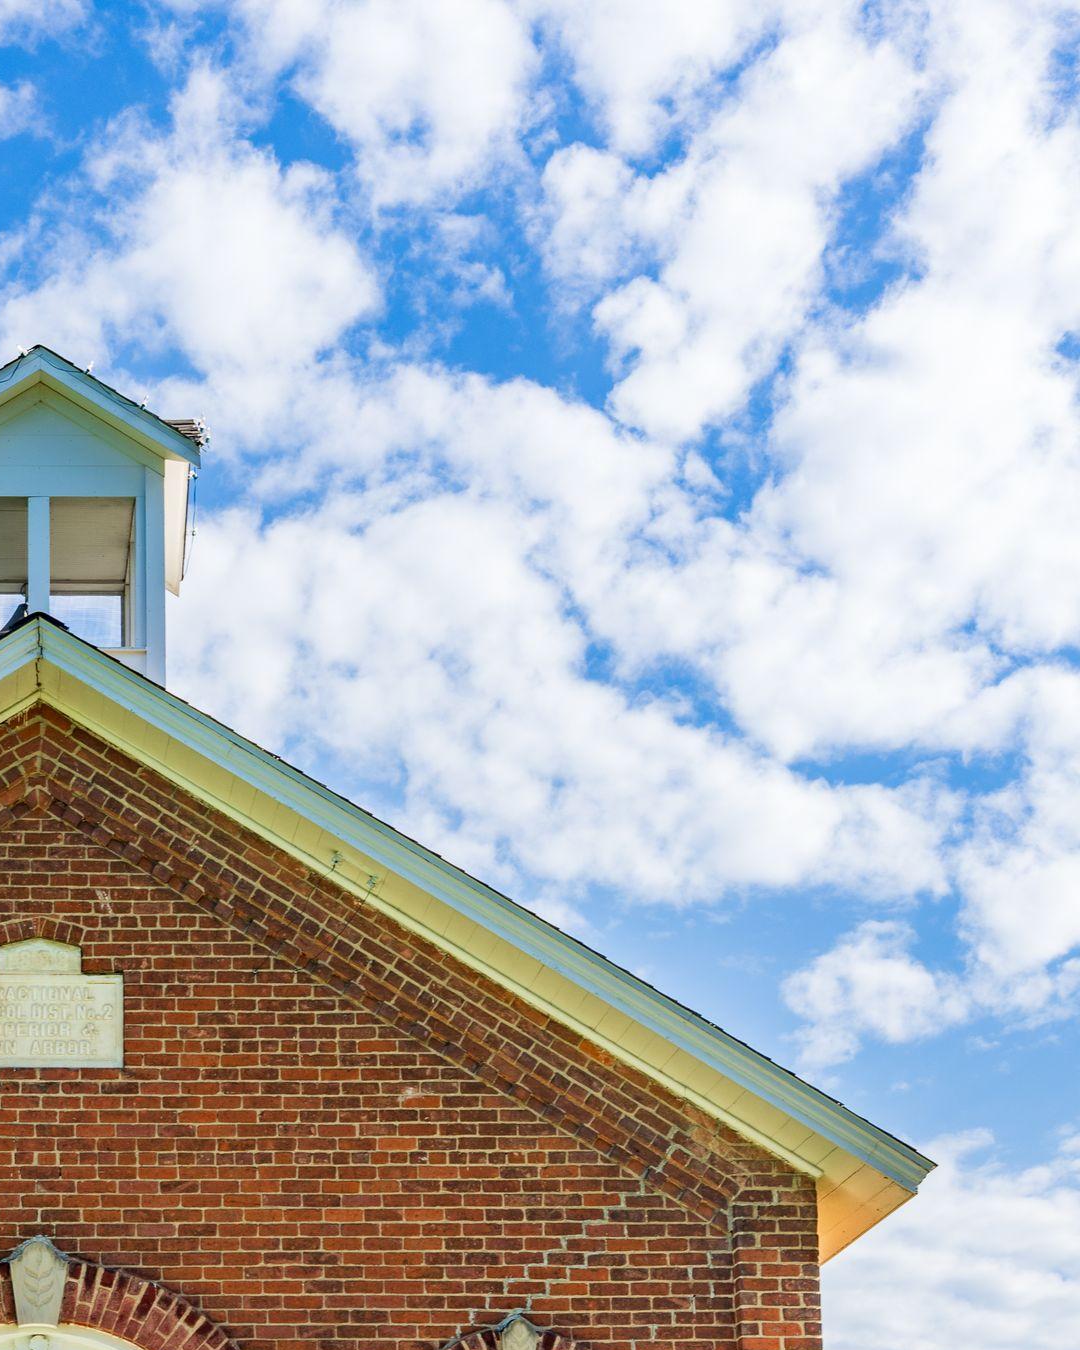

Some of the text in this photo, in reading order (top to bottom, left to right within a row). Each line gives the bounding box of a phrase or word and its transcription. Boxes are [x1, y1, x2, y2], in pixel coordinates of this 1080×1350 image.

[30, 1004, 72, 1019] DIST.
[81, 1023, 101, 1038] &
[30, 1039, 97, 1056] ARBOR.
